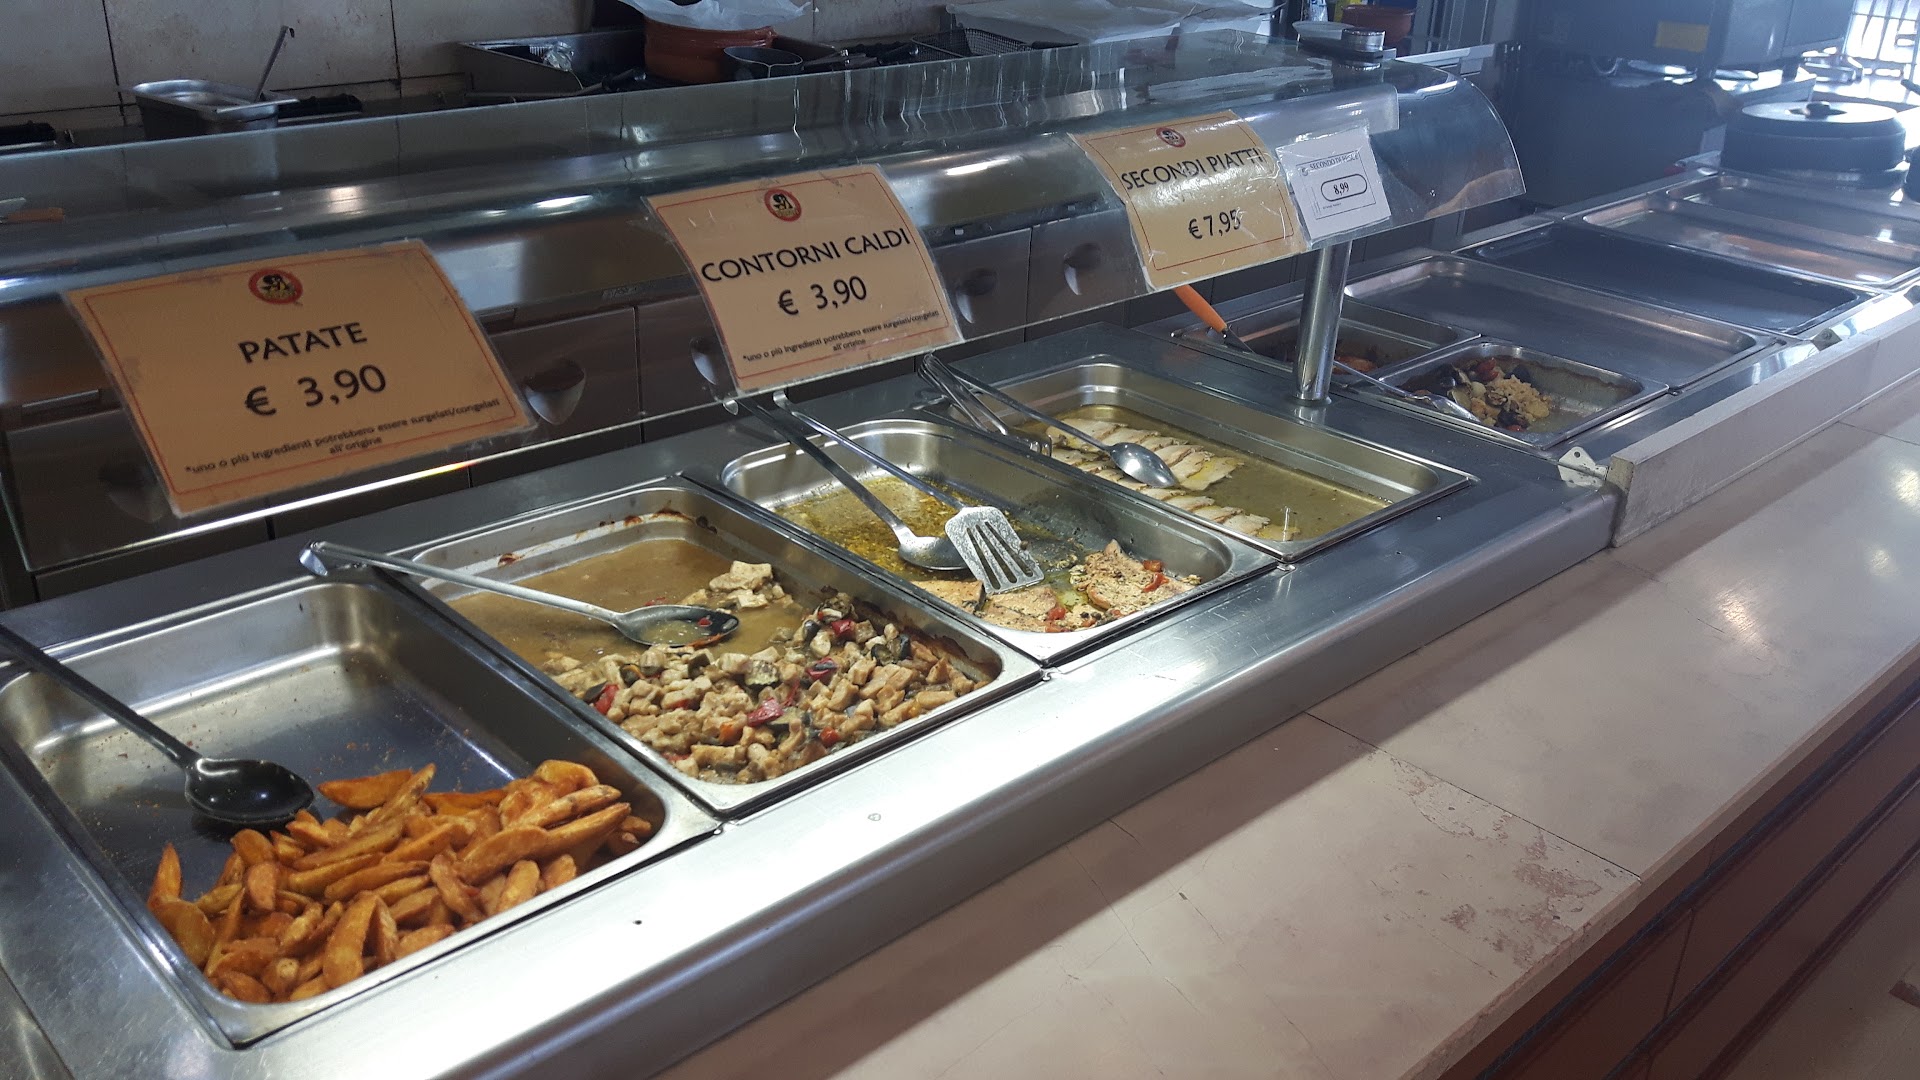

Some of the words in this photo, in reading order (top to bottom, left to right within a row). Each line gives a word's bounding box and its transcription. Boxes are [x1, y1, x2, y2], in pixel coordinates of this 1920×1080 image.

[1121, 158, 1206, 191] SECONDI
[1210, 147, 1265, 176] PIATTI
[1309, 158, 1336, 170] SECONDO
[1333, 181, 1349, 196] 8,99
[701, 241, 841, 283] CONTORNI
[844, 227, 911, 255] CALDI
[777, 289, 799, 316] €
[810, 275, 867, 311] 3,90
[238, 321, 368, 364] PATATE
[823, 329, 862, 345] potrebbero
[245, 386, 277, 417] €
[297, 364, 387, 409] 3,90
[315, 427, 375, 449] potrebbero
[378, 419, 408, 433] essere
